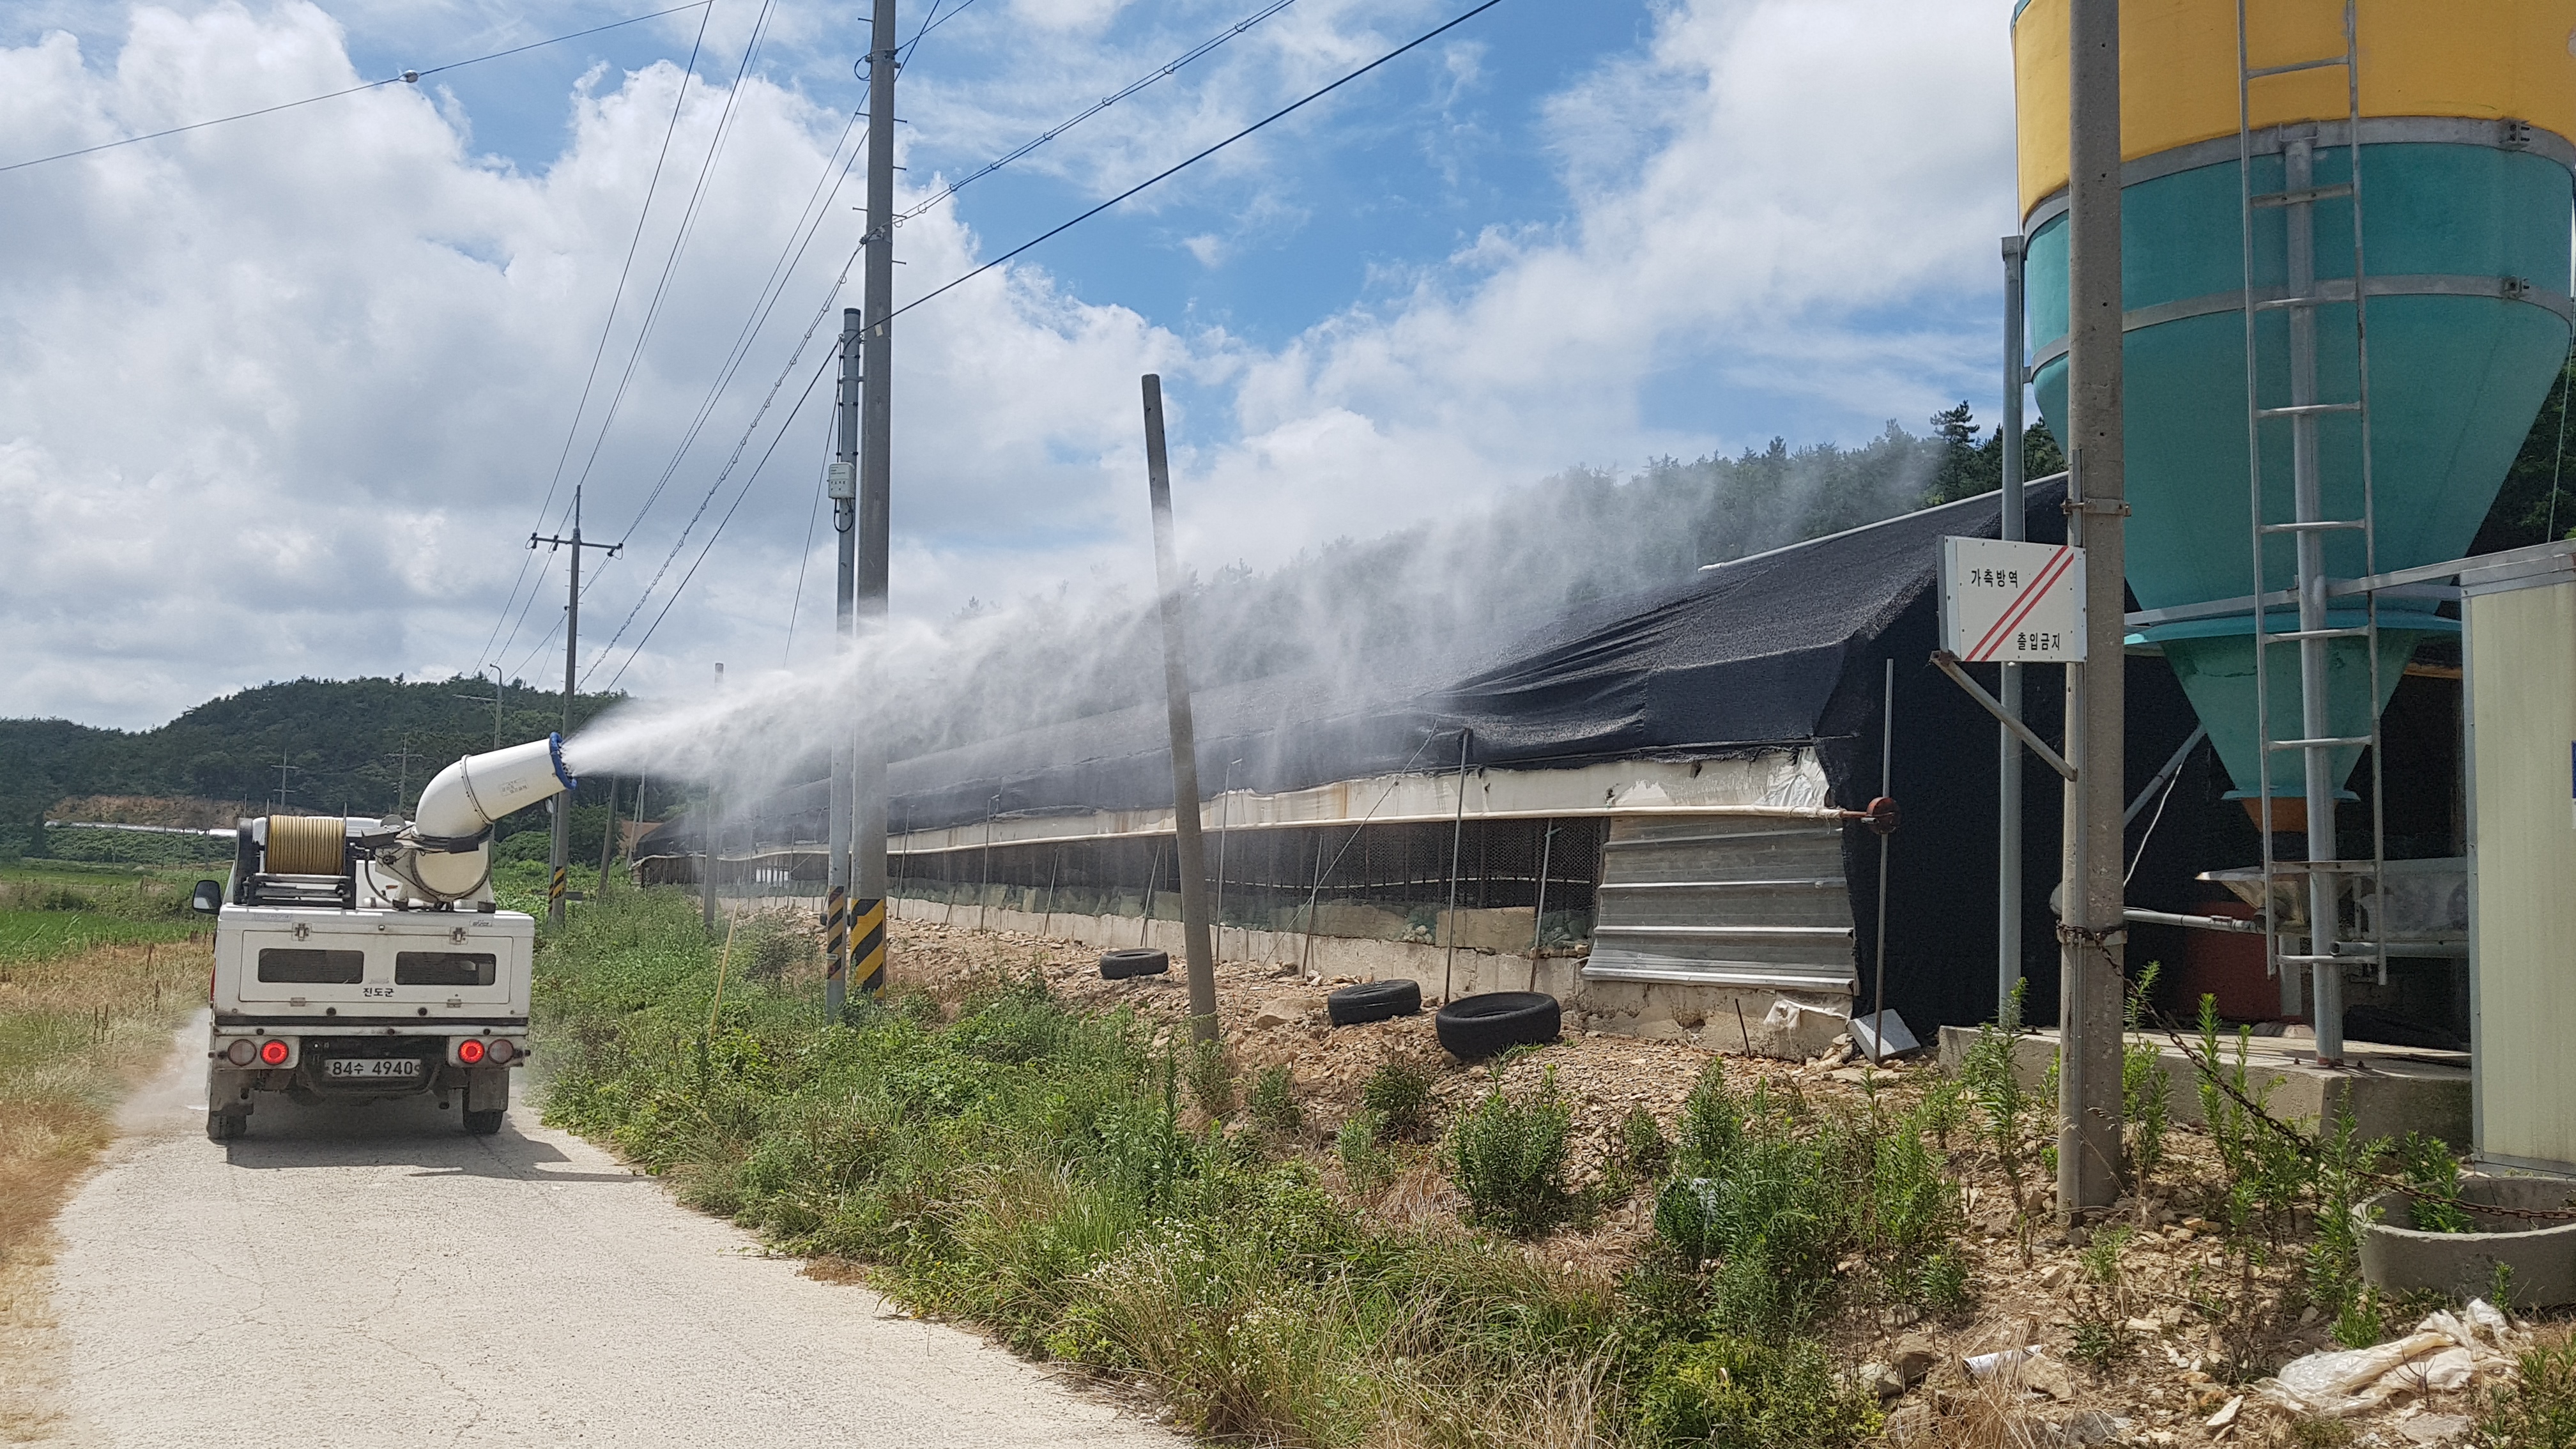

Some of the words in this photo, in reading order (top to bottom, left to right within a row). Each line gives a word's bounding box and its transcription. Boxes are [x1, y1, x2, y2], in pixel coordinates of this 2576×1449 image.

[1971, 568, 2018, 588] 가축방역
[2017, 632, 2060, 651] 출입금지
[362, 987, 394, 997] 진도군
[332, 1061, 364, 1075] 84수
[372, 1061, 413, 1075] 4940
